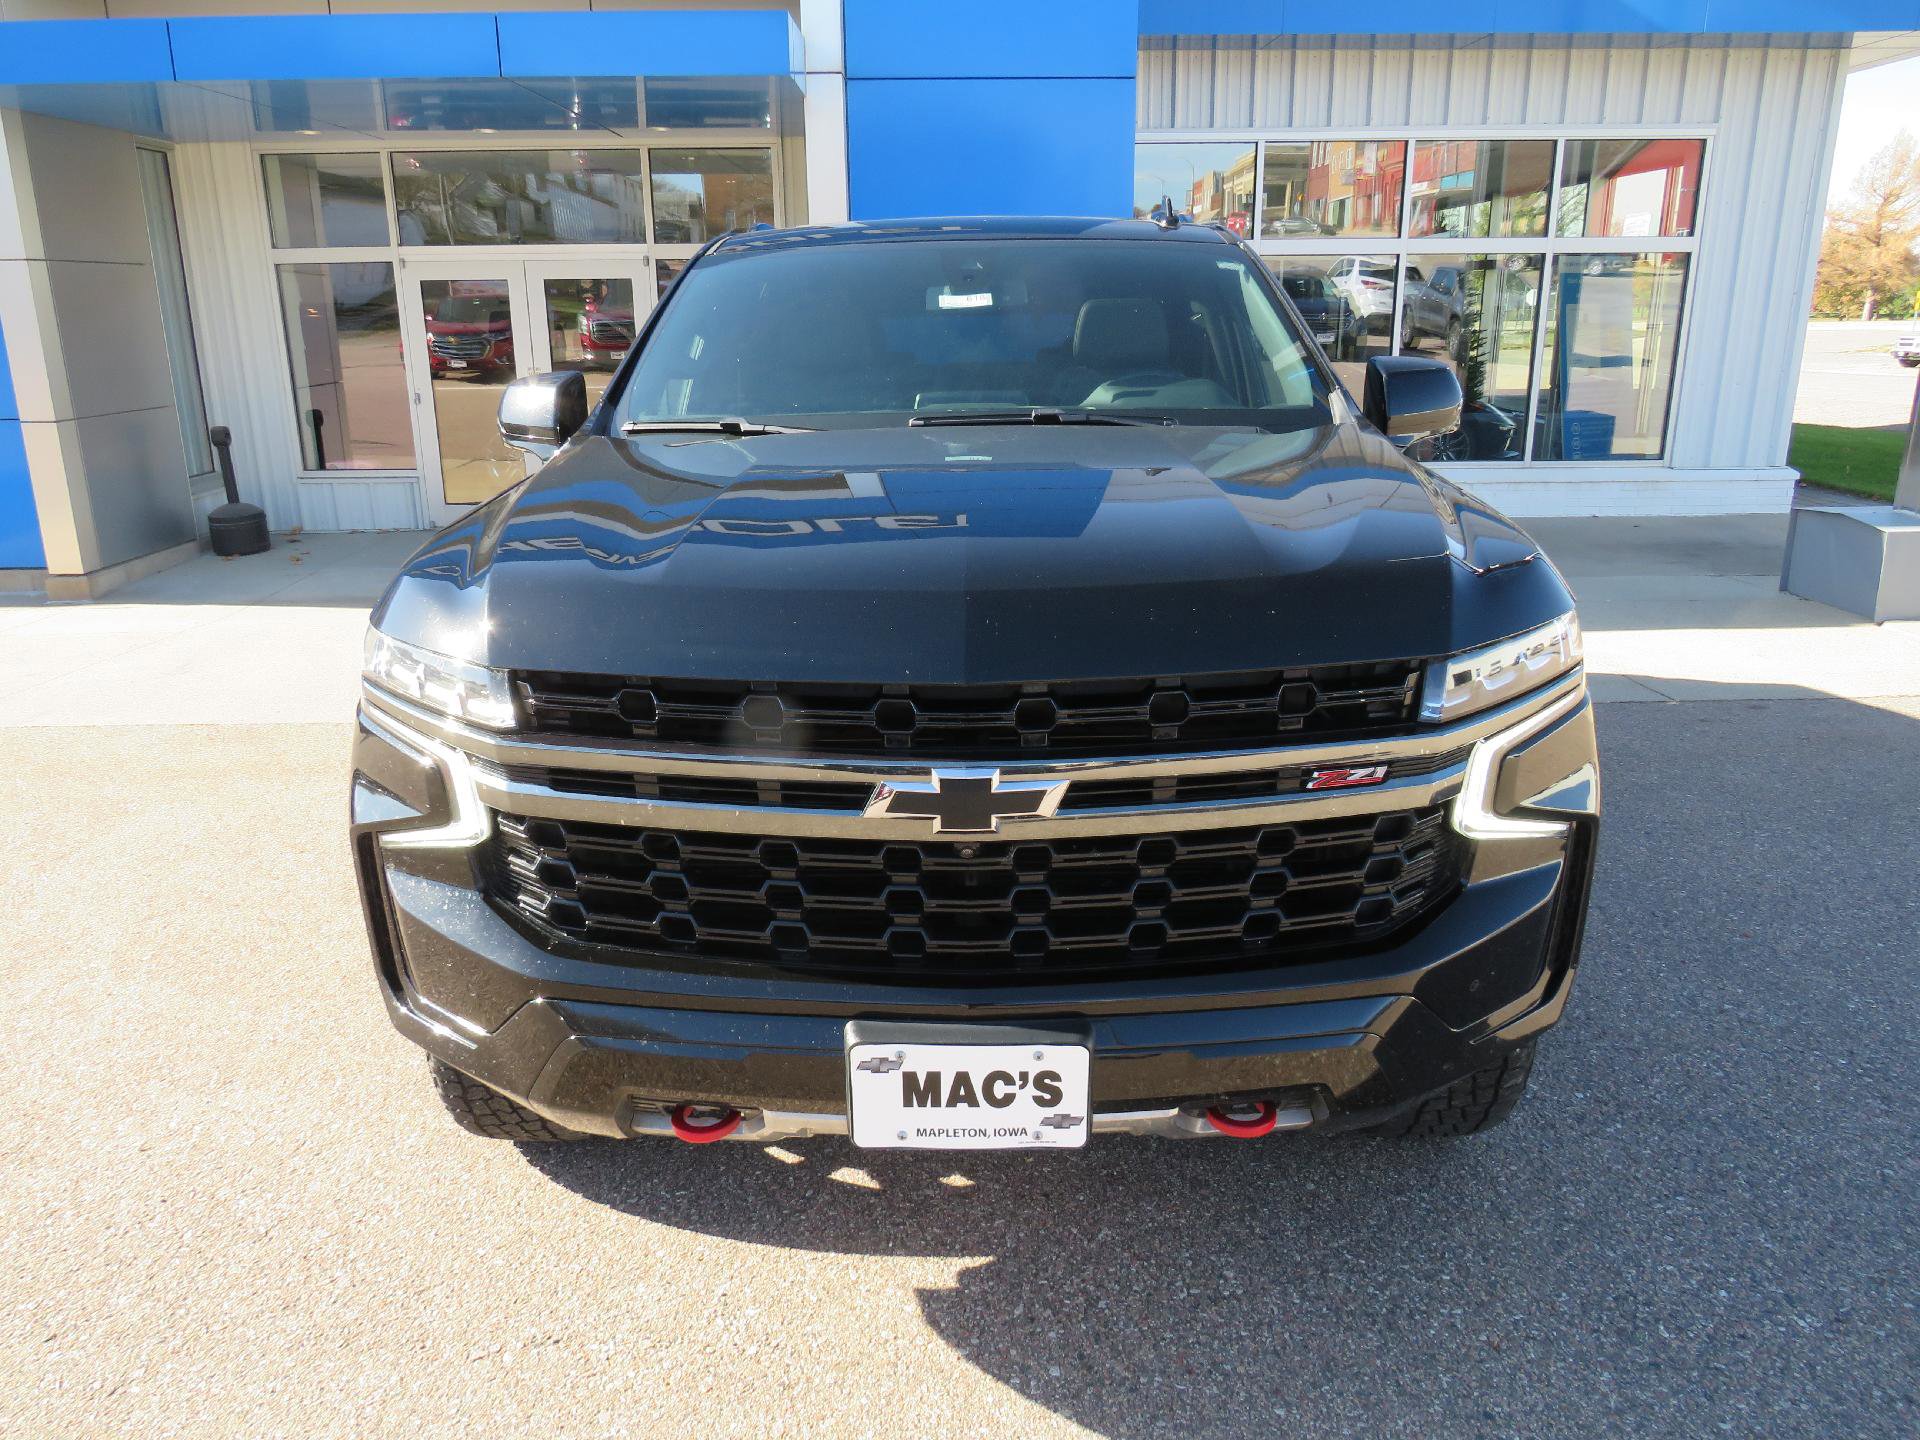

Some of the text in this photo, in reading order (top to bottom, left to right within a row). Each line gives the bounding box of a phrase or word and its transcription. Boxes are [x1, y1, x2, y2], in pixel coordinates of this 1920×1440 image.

[1306, 765, 1388, 789] Z71
[902, 1070, 1064, 1108] MAC'S
[916, 1127, 1028, 1139] MAPLETON, IOWA
